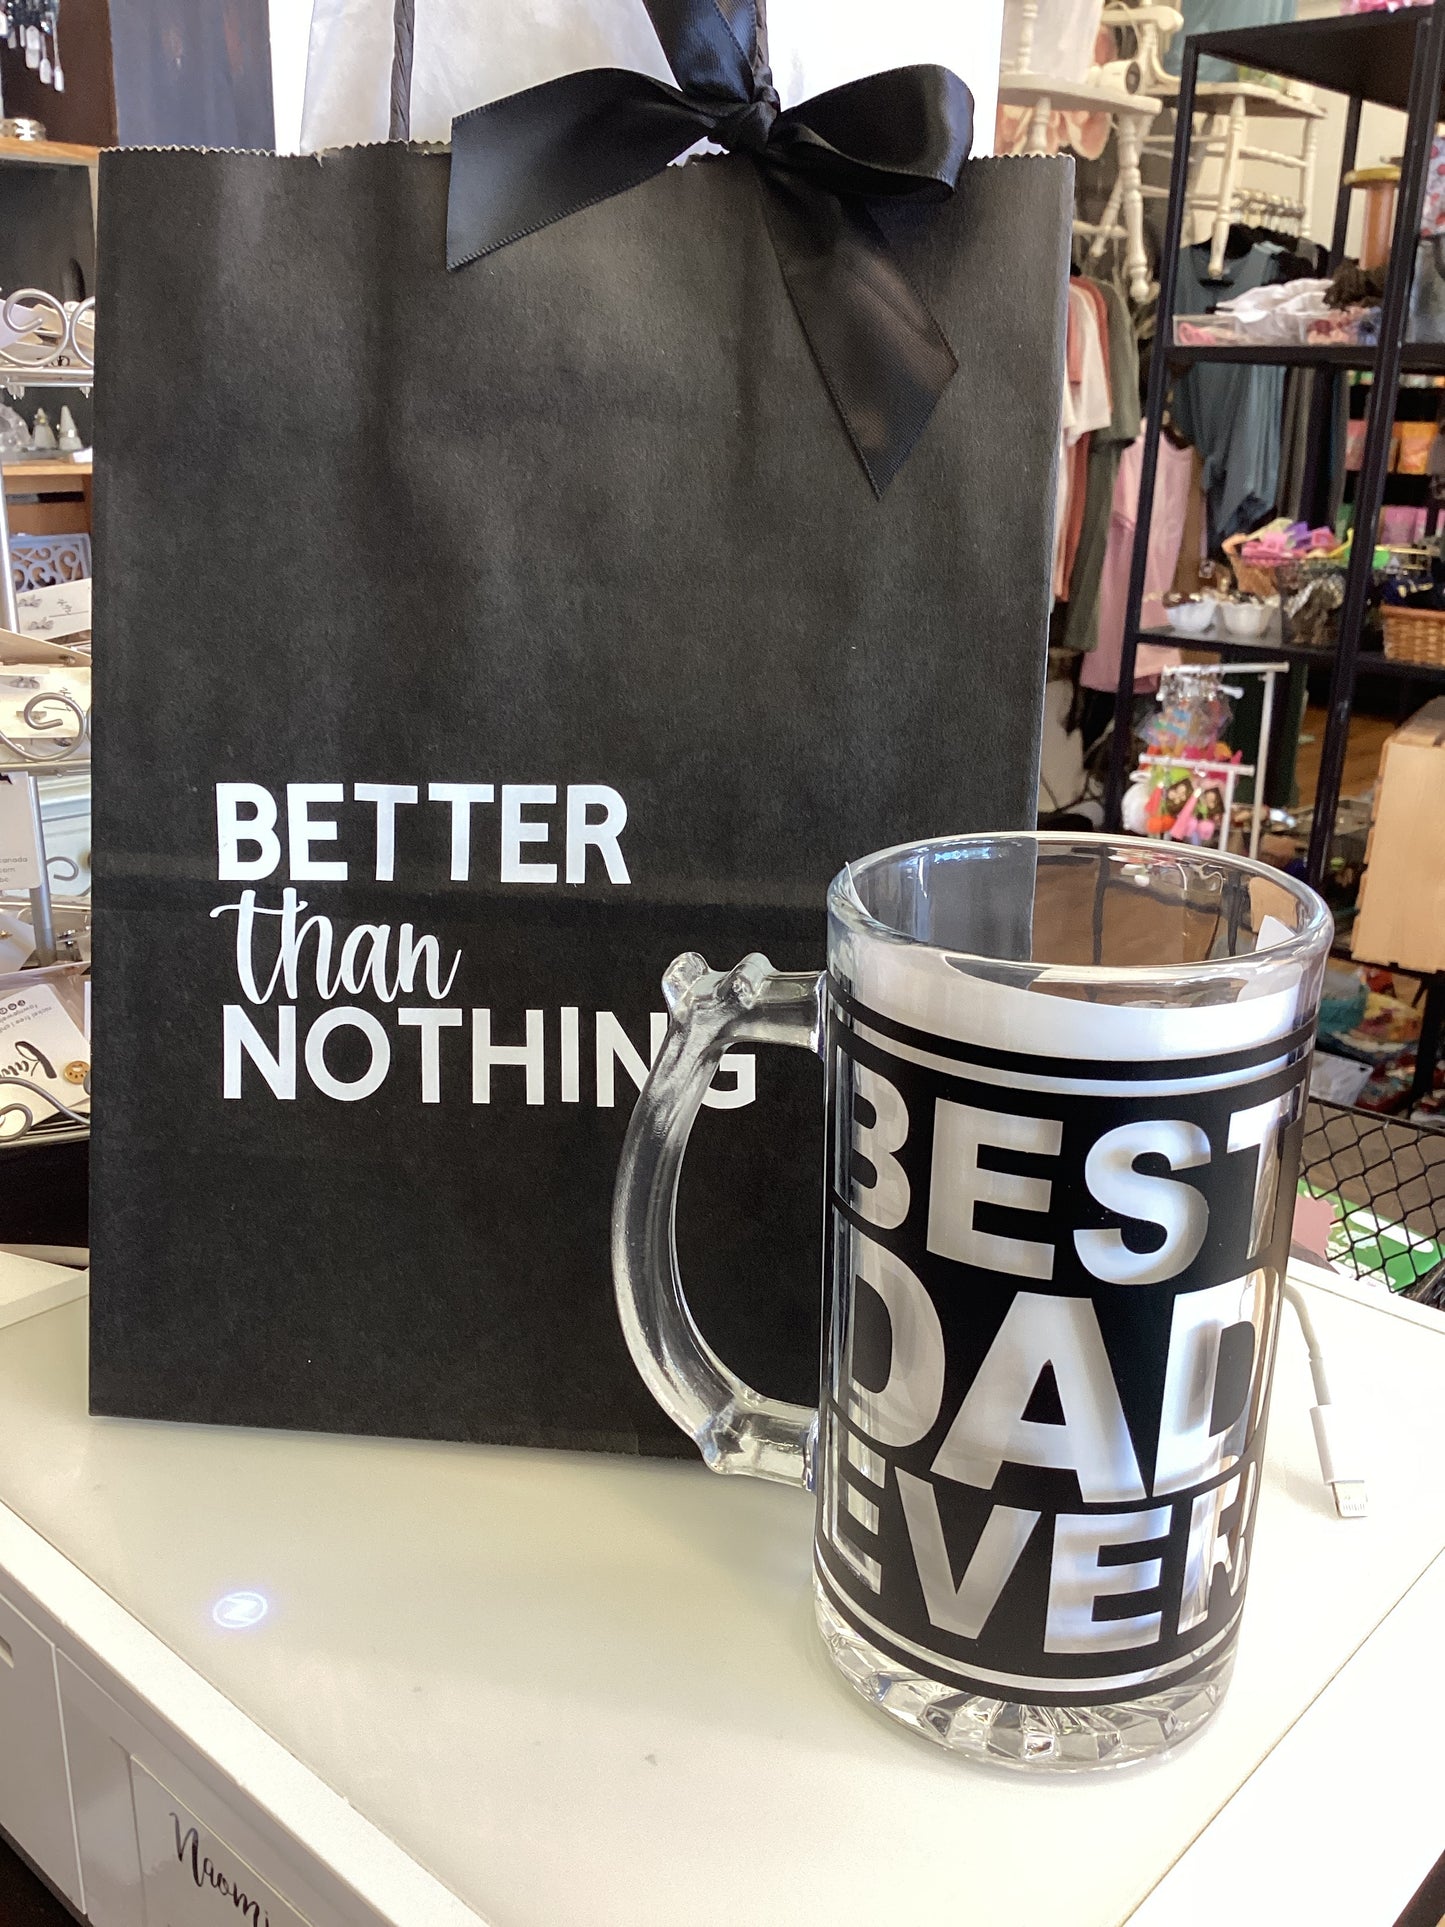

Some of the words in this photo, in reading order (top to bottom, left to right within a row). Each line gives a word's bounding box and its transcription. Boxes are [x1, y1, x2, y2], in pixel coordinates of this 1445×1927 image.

[215, 782, 632, 885] BETTER
[209, 887, 462, 1005] than
[833, 1044, 1306, 1285] BEST
[831, 1202, 1282, 1503] DAD
[822, 1404, 1258, 1655] EVER
[169, 1812, 269, 1927] Naomi
